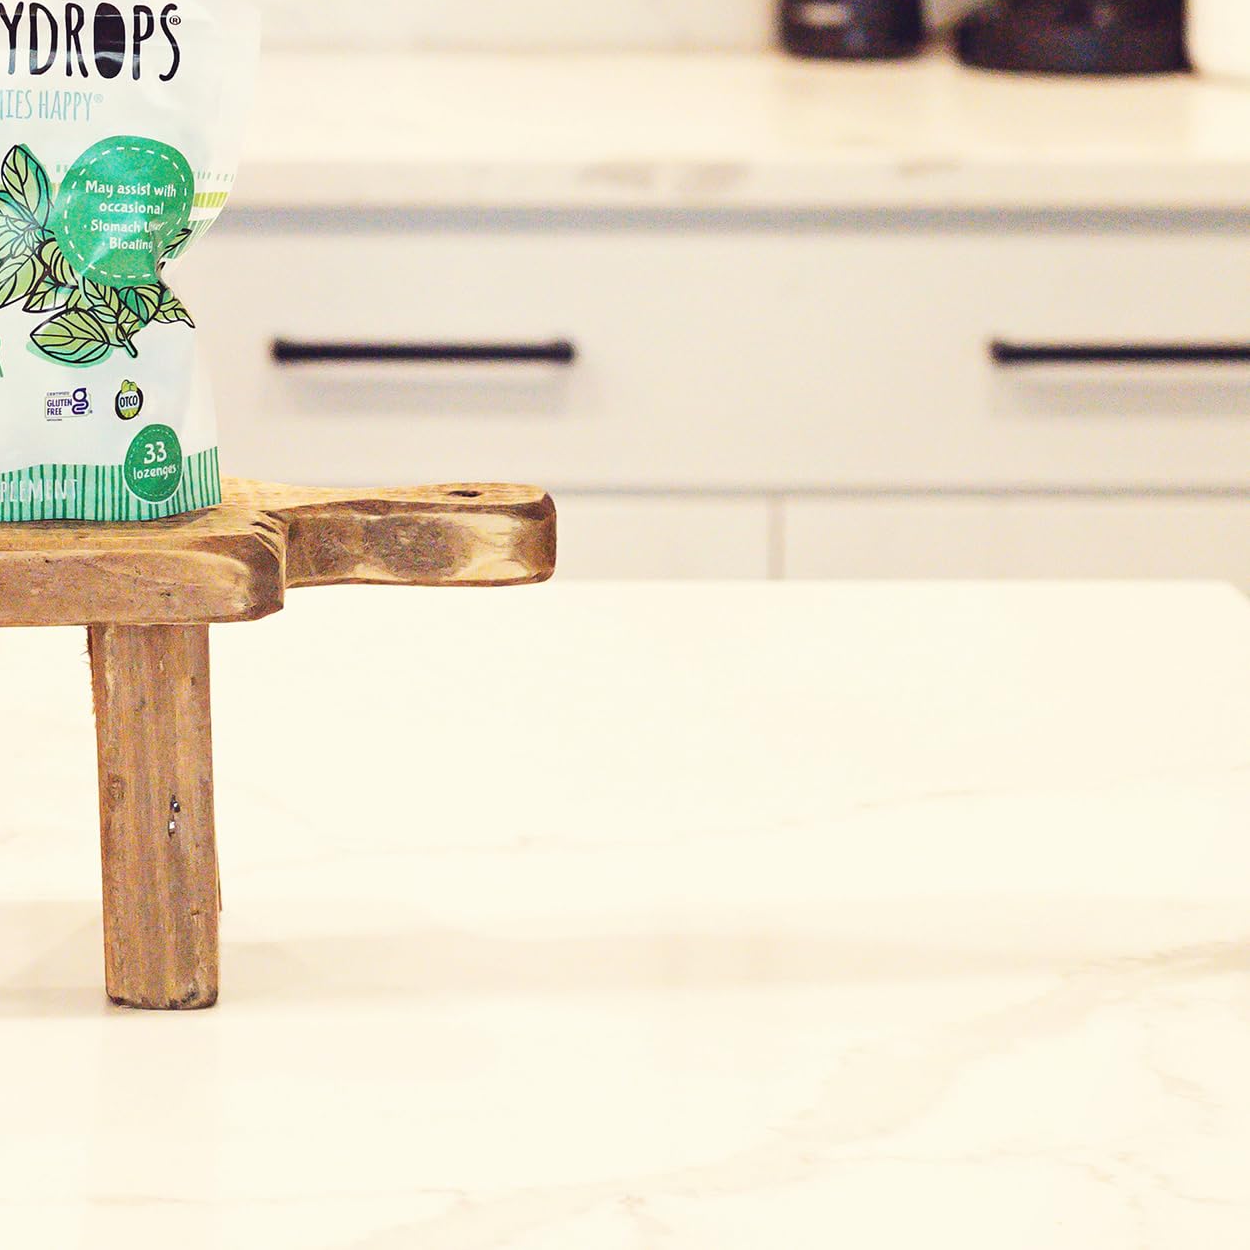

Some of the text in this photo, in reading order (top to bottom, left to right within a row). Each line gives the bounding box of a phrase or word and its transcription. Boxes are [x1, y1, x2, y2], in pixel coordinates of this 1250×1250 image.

[85, 180, 177, 198] May assist with
[99, 201, 164, 215] occasional
[90, 219, 141, 233] Stomach
[109, 236, 154, 253] Bloating
[46, 398, 73, 408] GLUTEN
[119, 395, 139, 408] OTCO
[46, 407, 63, 416] FREE
[143, 441, 167, 465] 33
[133, 463, 177, 480] lozenges
